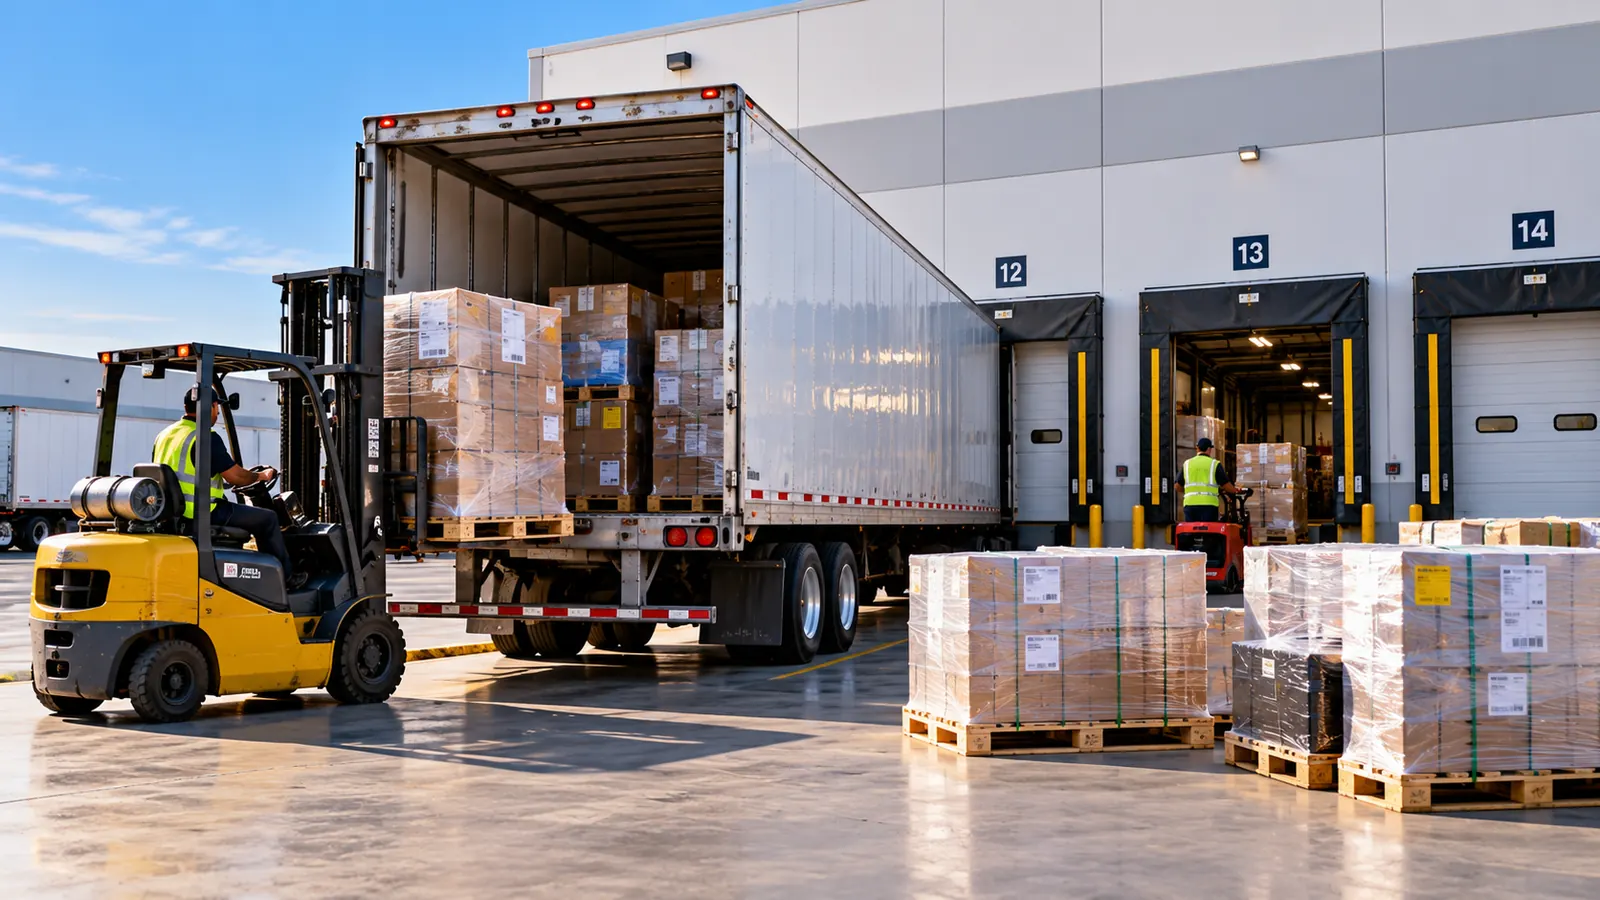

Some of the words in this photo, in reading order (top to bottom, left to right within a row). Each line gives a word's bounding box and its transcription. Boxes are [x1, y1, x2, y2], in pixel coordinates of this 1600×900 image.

[1517, 218, 1549, 243] 14
[1237, 241, 1264, 265] 13
[1000, 261, 1022, 283] 12
